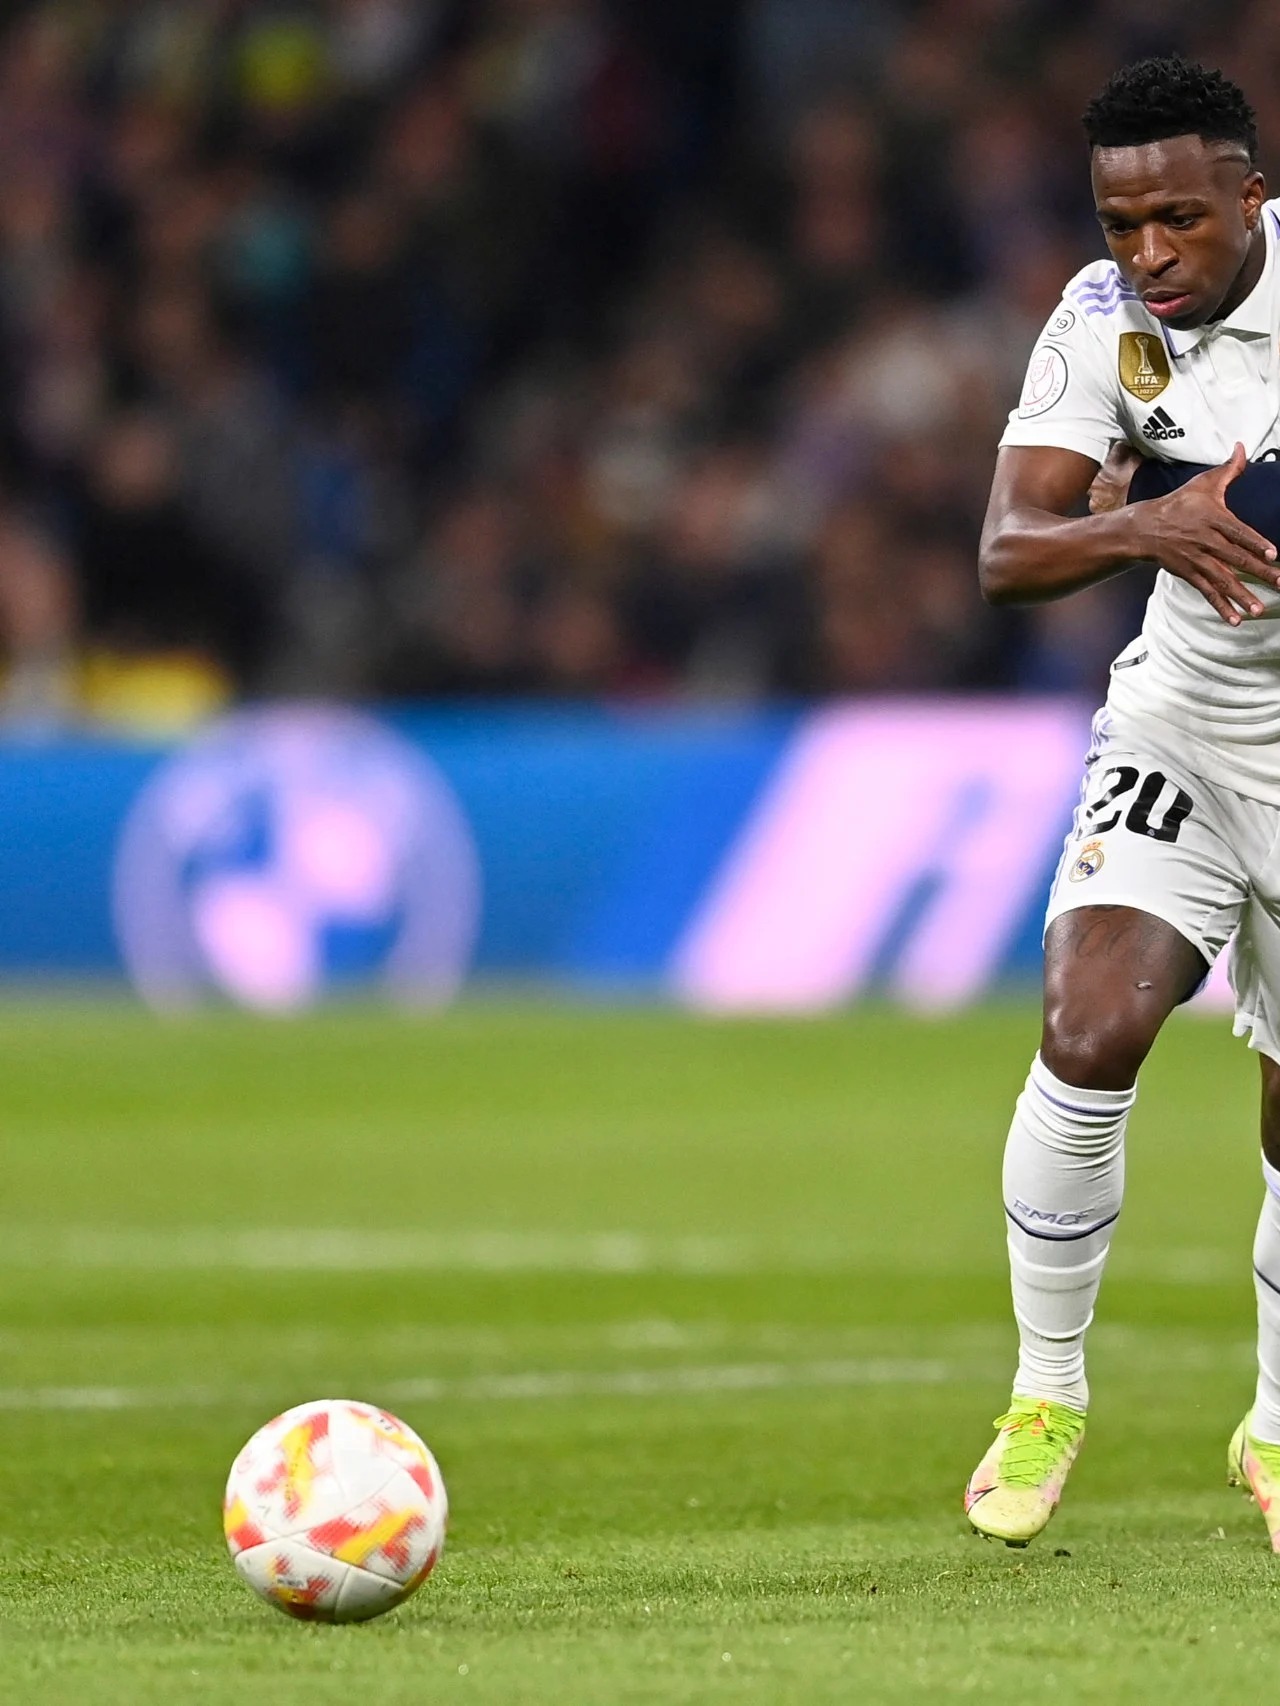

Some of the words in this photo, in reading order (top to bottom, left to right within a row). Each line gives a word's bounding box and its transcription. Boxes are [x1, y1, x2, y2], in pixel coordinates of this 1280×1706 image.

[1134, 375, 1158, 385] FIFA
[1142, 426, 1186, 441] adidas
[1076, 766, 1194, 843] 20
